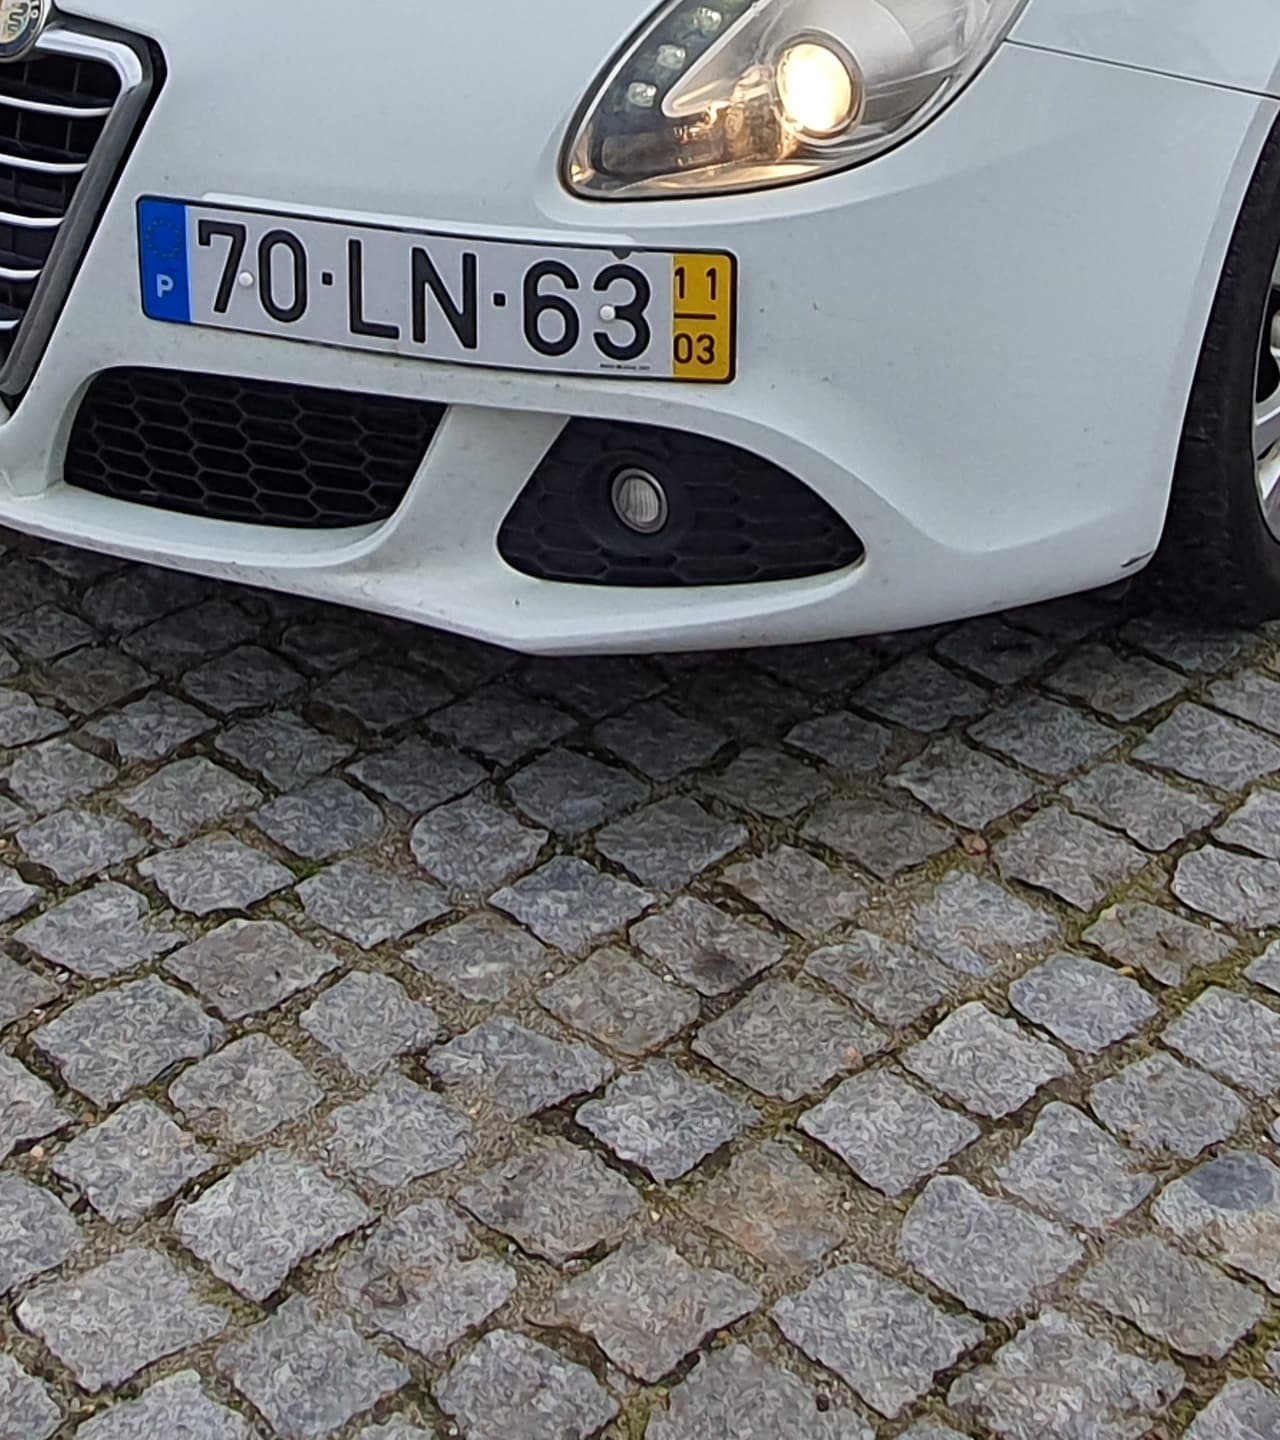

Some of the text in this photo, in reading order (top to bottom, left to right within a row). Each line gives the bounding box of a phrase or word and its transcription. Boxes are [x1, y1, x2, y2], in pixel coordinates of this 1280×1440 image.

[156, 219, 651, 361] P 70·LN·63
[674, 267, 717, 301] 11
[673, 333, 716, 365] 03
